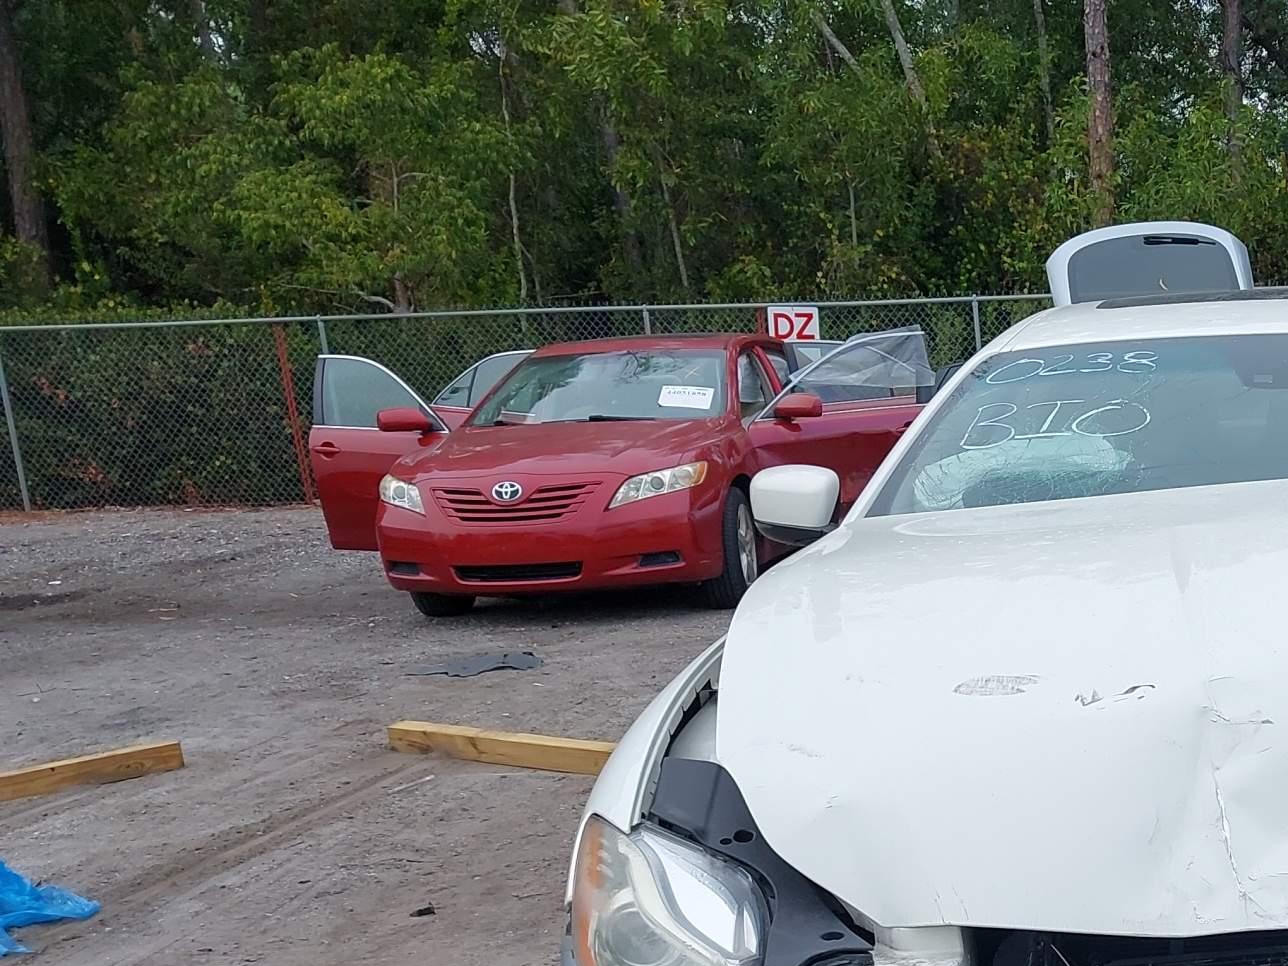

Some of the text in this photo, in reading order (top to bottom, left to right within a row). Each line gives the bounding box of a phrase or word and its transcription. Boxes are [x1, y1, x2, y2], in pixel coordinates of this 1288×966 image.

[773, 312, 816, 340] DZ
[985, 351, 1159, 385] 0238
[960, 399, 1152, 450] BIO
